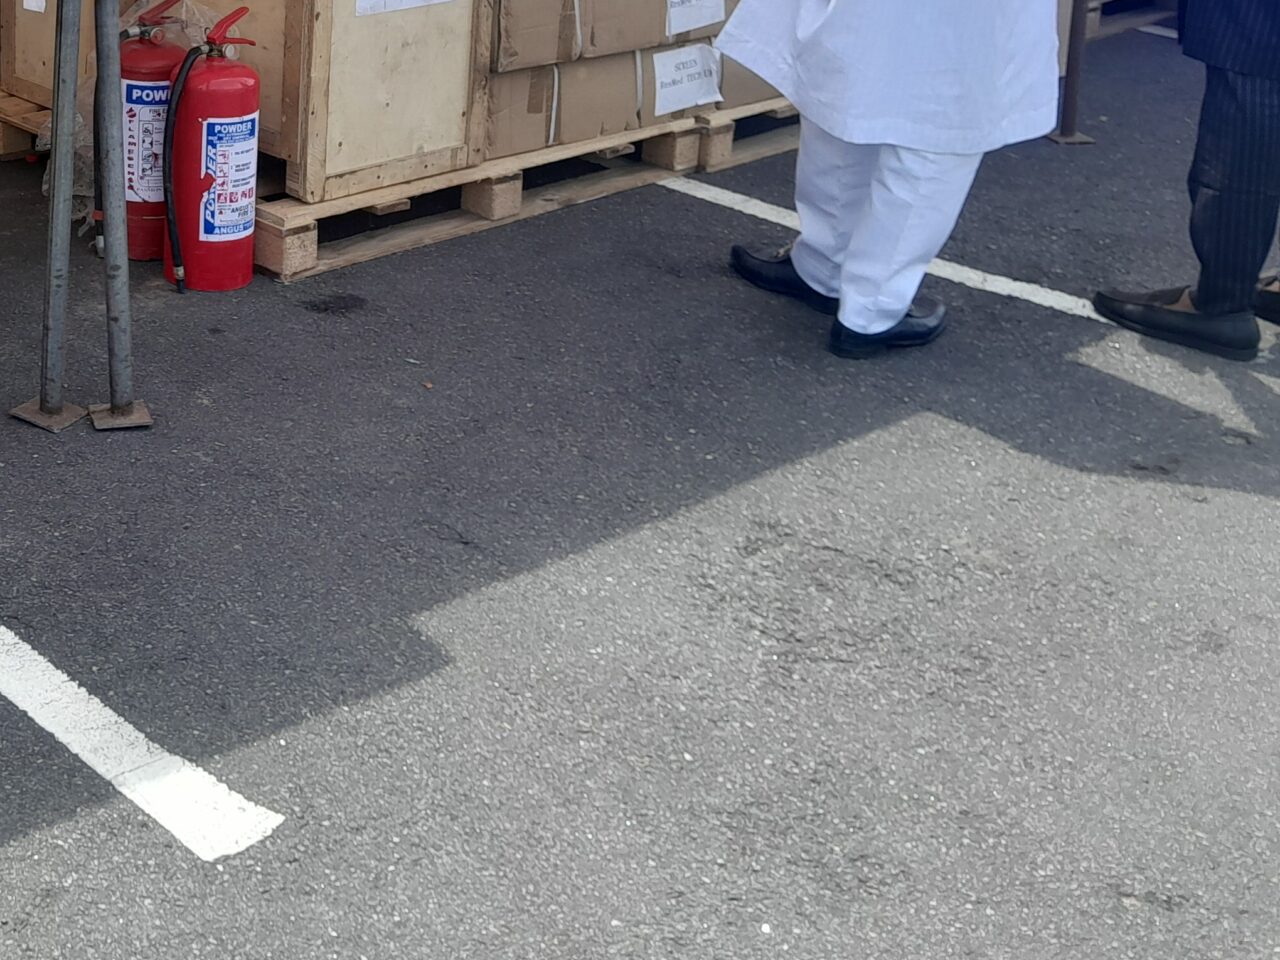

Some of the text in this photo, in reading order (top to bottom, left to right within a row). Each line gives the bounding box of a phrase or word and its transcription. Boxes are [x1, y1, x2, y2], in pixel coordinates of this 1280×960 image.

[214, 121, 253, 134] POWDER
[231, 204, 250, 213] ANGUS
[213, 223, 244, 235] ANGUS
